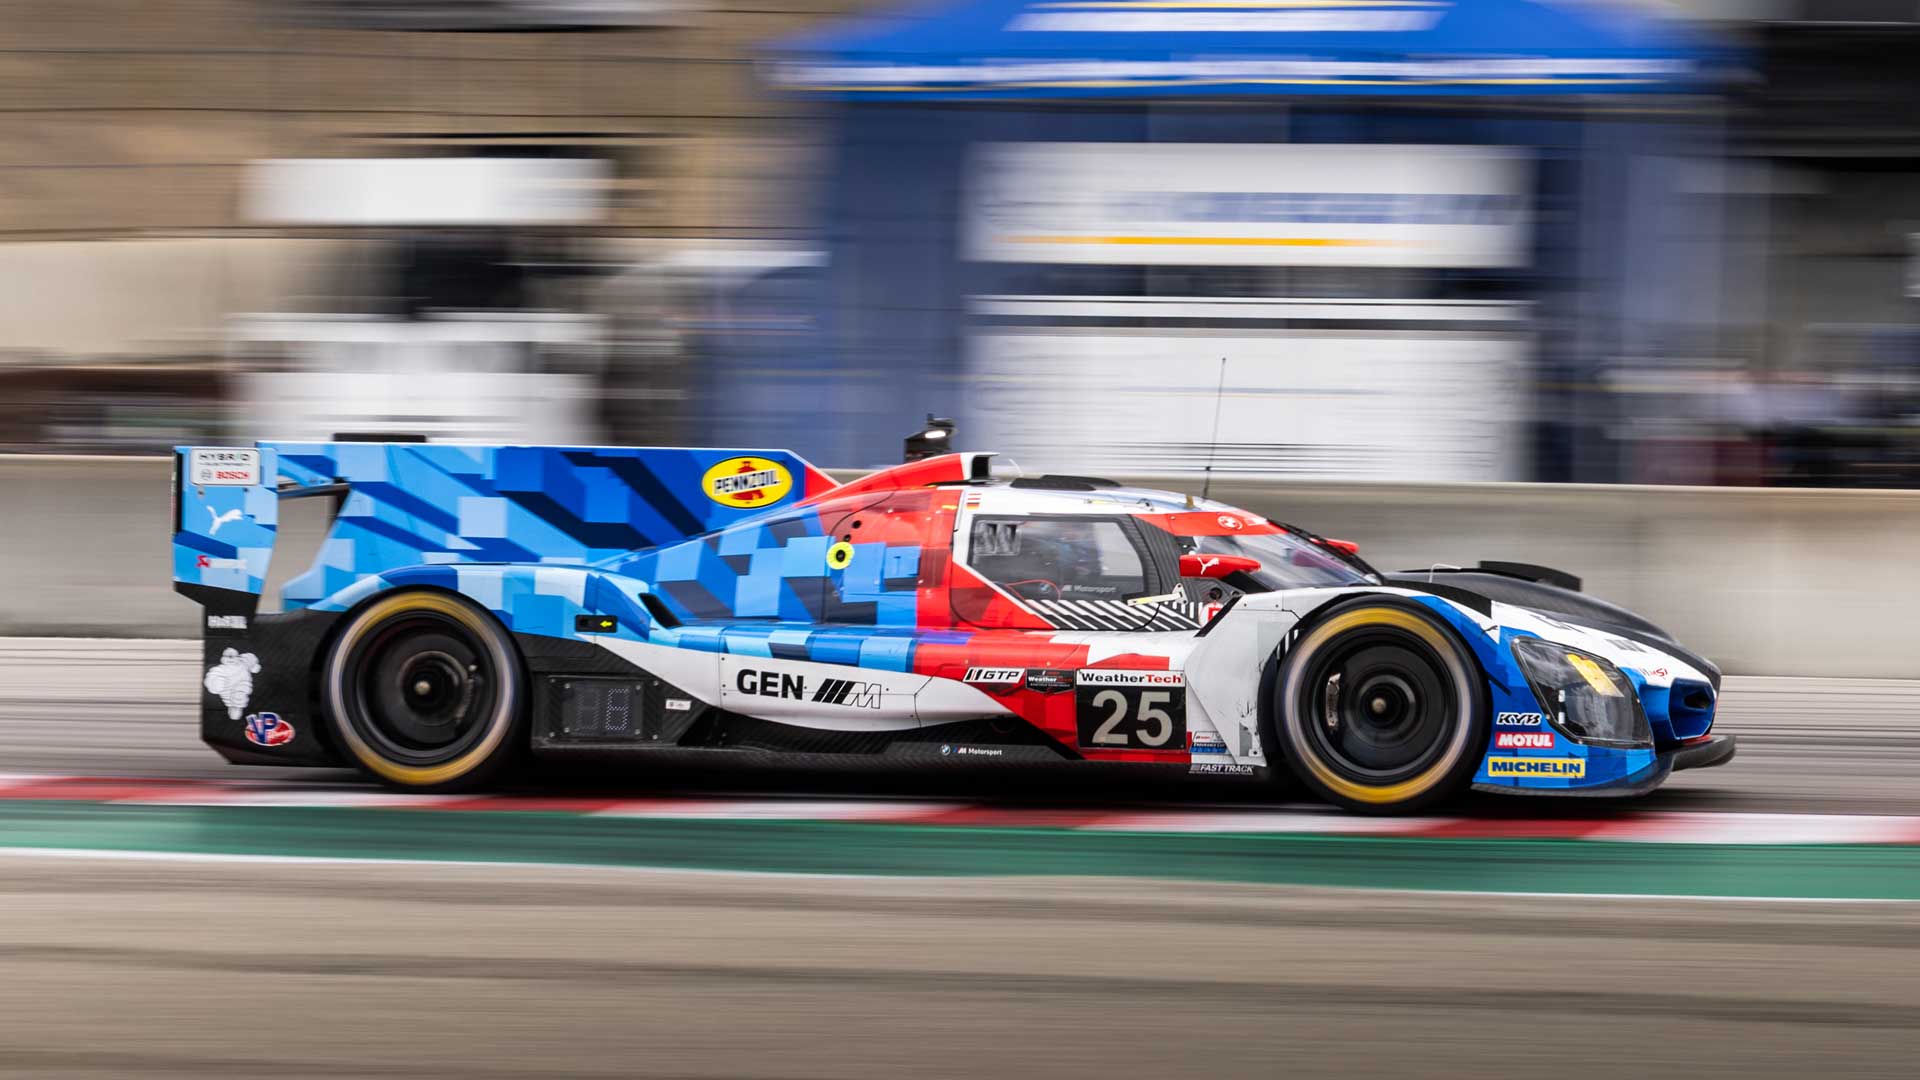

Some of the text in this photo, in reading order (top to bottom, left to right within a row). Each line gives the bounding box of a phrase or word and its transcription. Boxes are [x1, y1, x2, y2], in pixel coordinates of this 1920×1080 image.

[199, 453, 250, 461] HYBRID
[713, 469, 780, 496] PENNZOIL
[983, 670, 1020, 681] GTP
[1081, 672, 1182, 684] WeatherTech
[736, 668, 805, 701] GEN
[1091, 689, 1173, 747] 25
[1497, 712, 1542, 725] KYB
[247, 713, 280, 744] VP
[1498, 733, 1553, 747] MOTUL
[968, 747, 1003, 757] Motorsport
[1200, 764, 1224, 773] FAST
[1224, 764, 1253, 774] TRACK
[1491, 761, 1582, 774] MICHELIN
